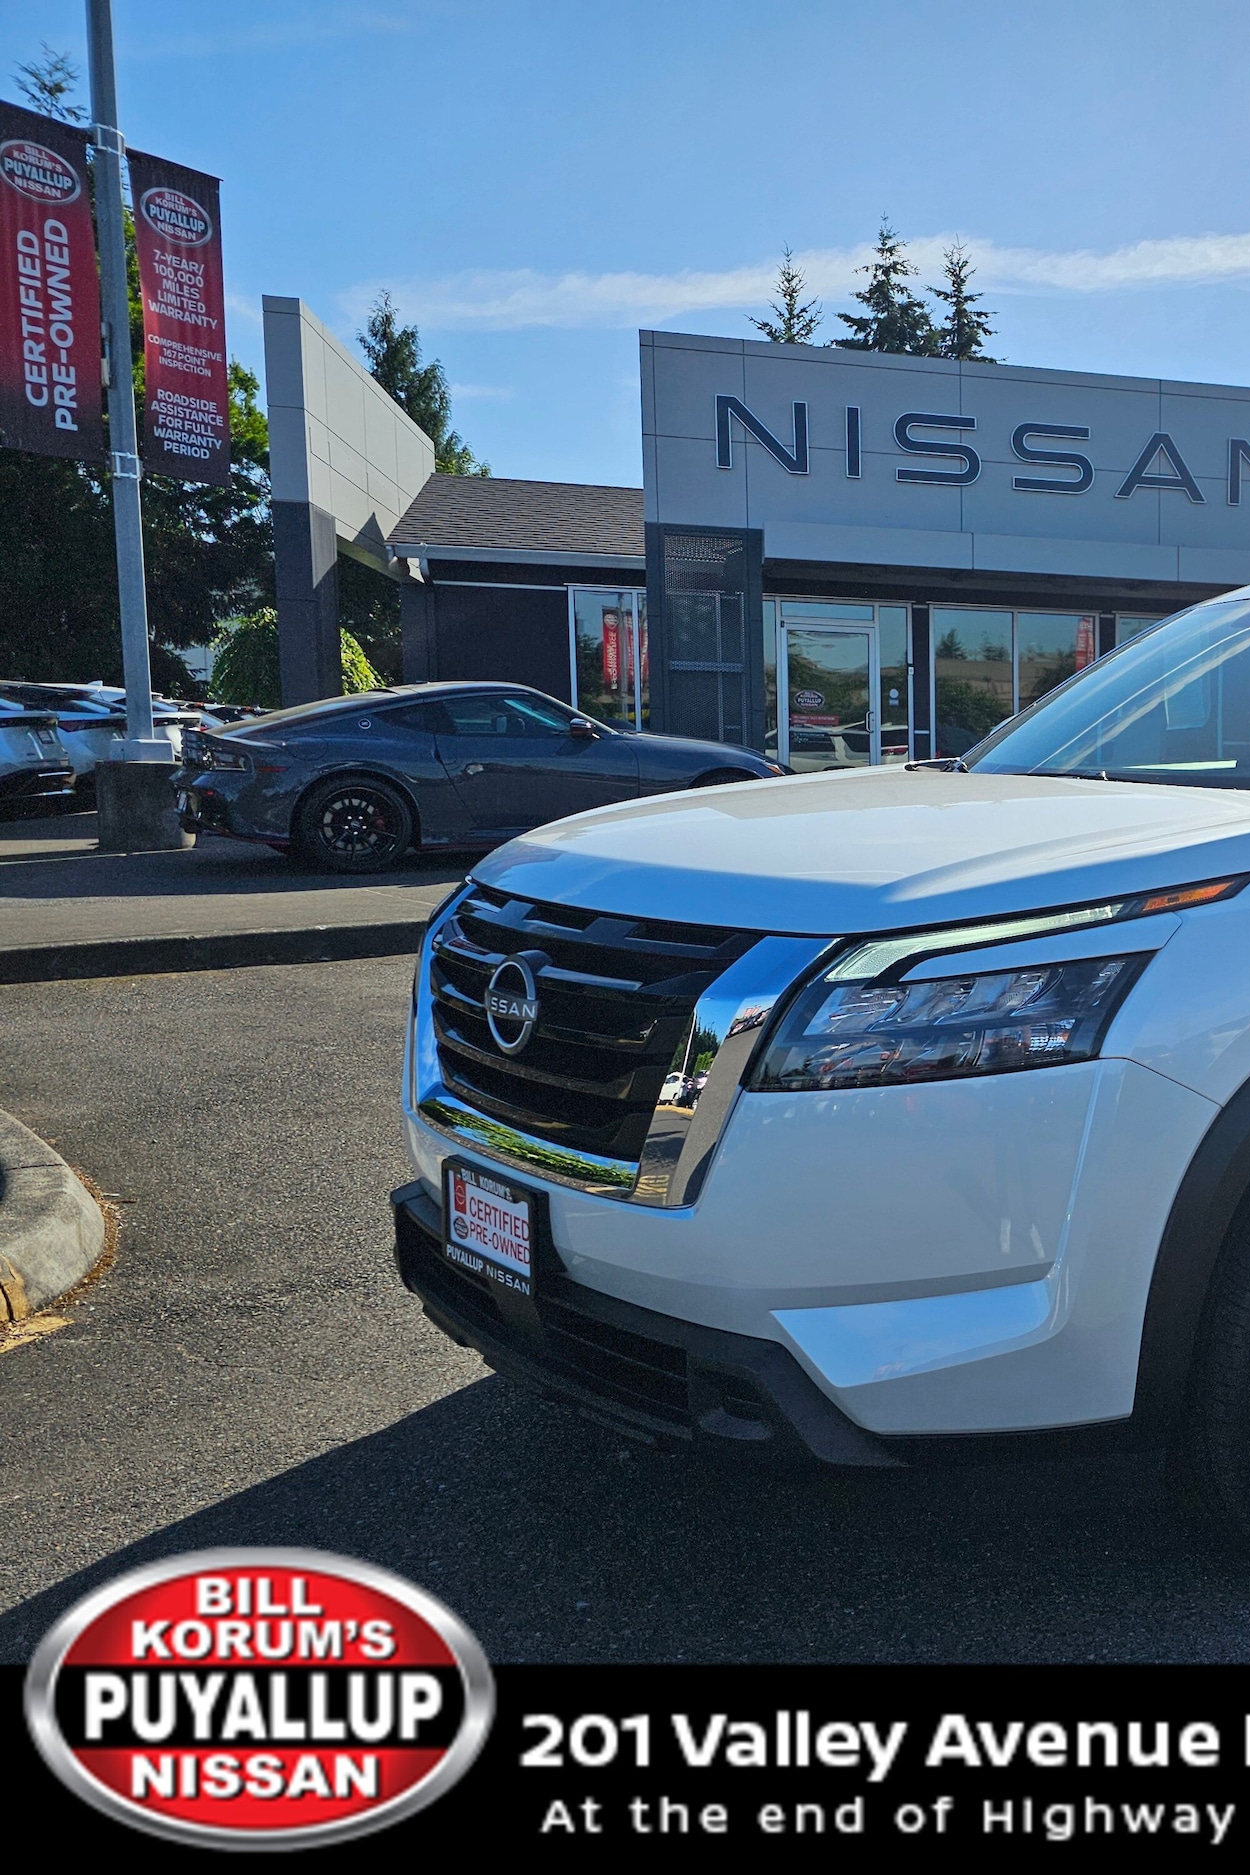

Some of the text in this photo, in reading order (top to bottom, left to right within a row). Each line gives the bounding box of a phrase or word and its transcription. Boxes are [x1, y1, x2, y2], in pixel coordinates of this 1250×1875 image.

[13, 149, 62, 172] KORUM'S
[24, 145, 48, 160] BILL
[4, 157, 72, 190] PUYALLUP
[14, 175, 62, 198] NISSAN
[165, 192, 185, 205] BILL
[149, 204, 206, 232] PUYALLUP
[155, 197, 198, 216] KORUM'S
[157, 221, 196, 240] NISSAN
[152, 262, 204, 288] 100,000
[153, 249, 205, 276] 7-YEAR/
[162, 278, 200, 299] MILES
[147, 299, 218, 329] WARRANTY
[157, 290, 206, 313] LIMITED
[17, 230, 49, 407] CERTIFIED
[44, 218, 78, 431] PRE-OWNED
[147, 334, 222, 362] COMPREHENSIVE
[162, 347, 207, 367] 167 POINT
[158, 356, 212, 377] INSPECTION
[151, 400, 224, 426] ASSISTANCE
[157, 388, 217, 413] ROADSIDE
[153, 425, 222, 450] WARRANTY
[158, 414, 215, 437] FOR FULL
[163, 440, 210, 459] PERIOD
[490, 996, 536, 1019] SSAN
[461, 1168, 476, 1185] BILL
[479, 1174, 512, 1200] KORUM'S
[469, 1196, 530, 1242] CERTIFIED
[469, 1221, 531, 1265] PRE-OWNED
[446, 1244, 530, 1296] PUYALLUP NISSAN
